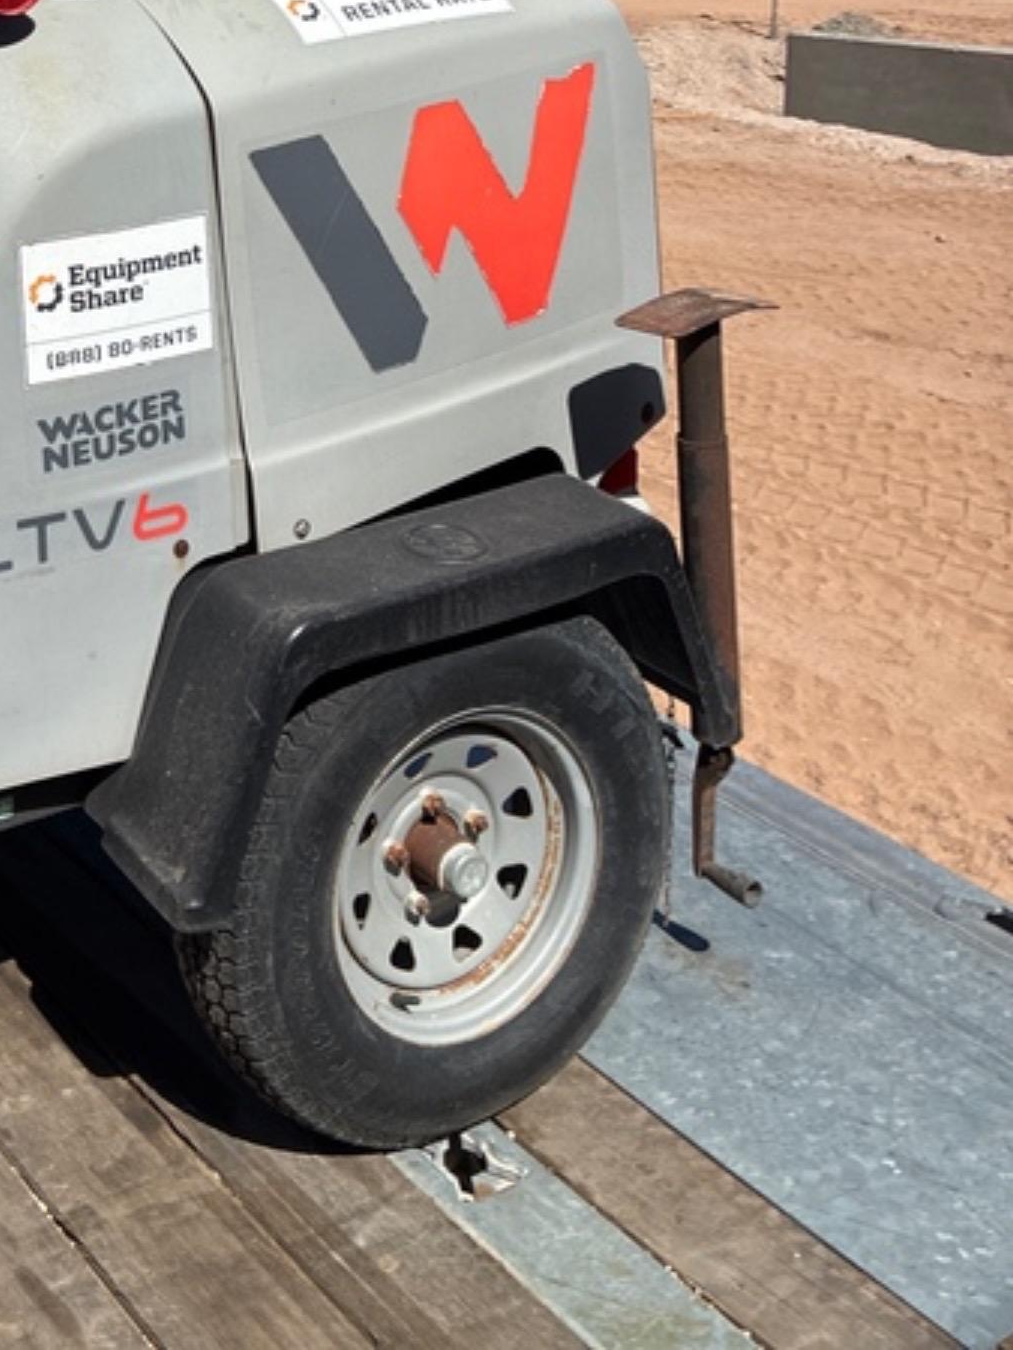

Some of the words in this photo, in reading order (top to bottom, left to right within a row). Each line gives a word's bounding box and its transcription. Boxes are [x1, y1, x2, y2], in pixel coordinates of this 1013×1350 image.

[67, 244, 202, 288] Equipment
[68, 282, 145, 313] Share
[108, 325, 198, 358] 80-RENTS
[37, 389, 184, 445] WACKER
[42, 416, 186, 473] NEUSON
